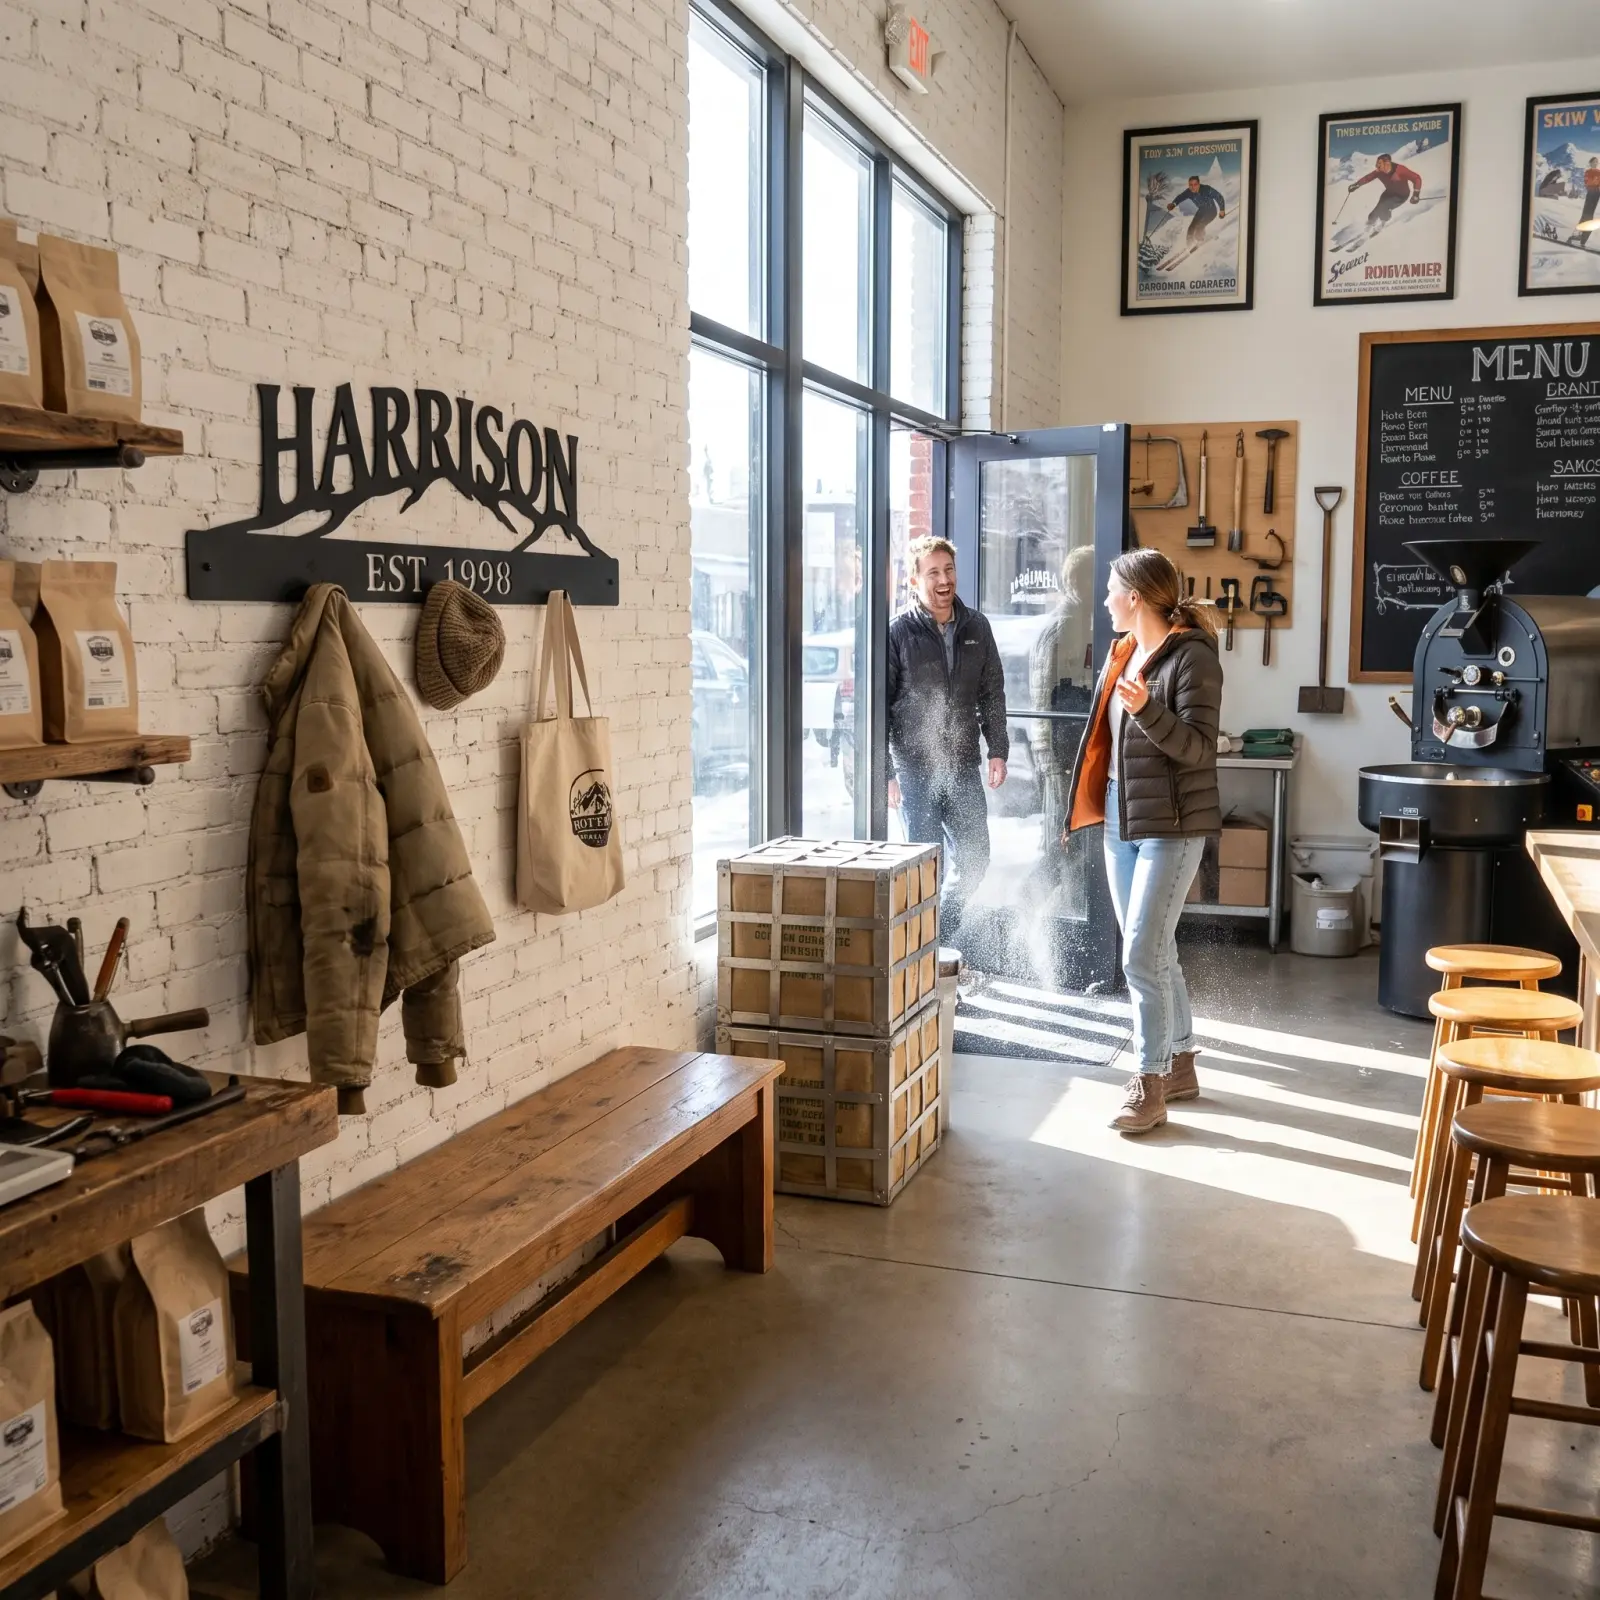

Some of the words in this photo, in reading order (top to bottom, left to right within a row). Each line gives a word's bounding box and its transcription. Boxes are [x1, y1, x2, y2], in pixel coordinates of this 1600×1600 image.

[1471, 342, 1590, 382] MENU
[1405, 385, 1453, 402] MENU
[257, 382, 579, 521] HARRISON
[1401, 470, 1459, 486] COFFEE
[366, 553, 427, 593] EST
[444, 558, 511, 595] 1998
